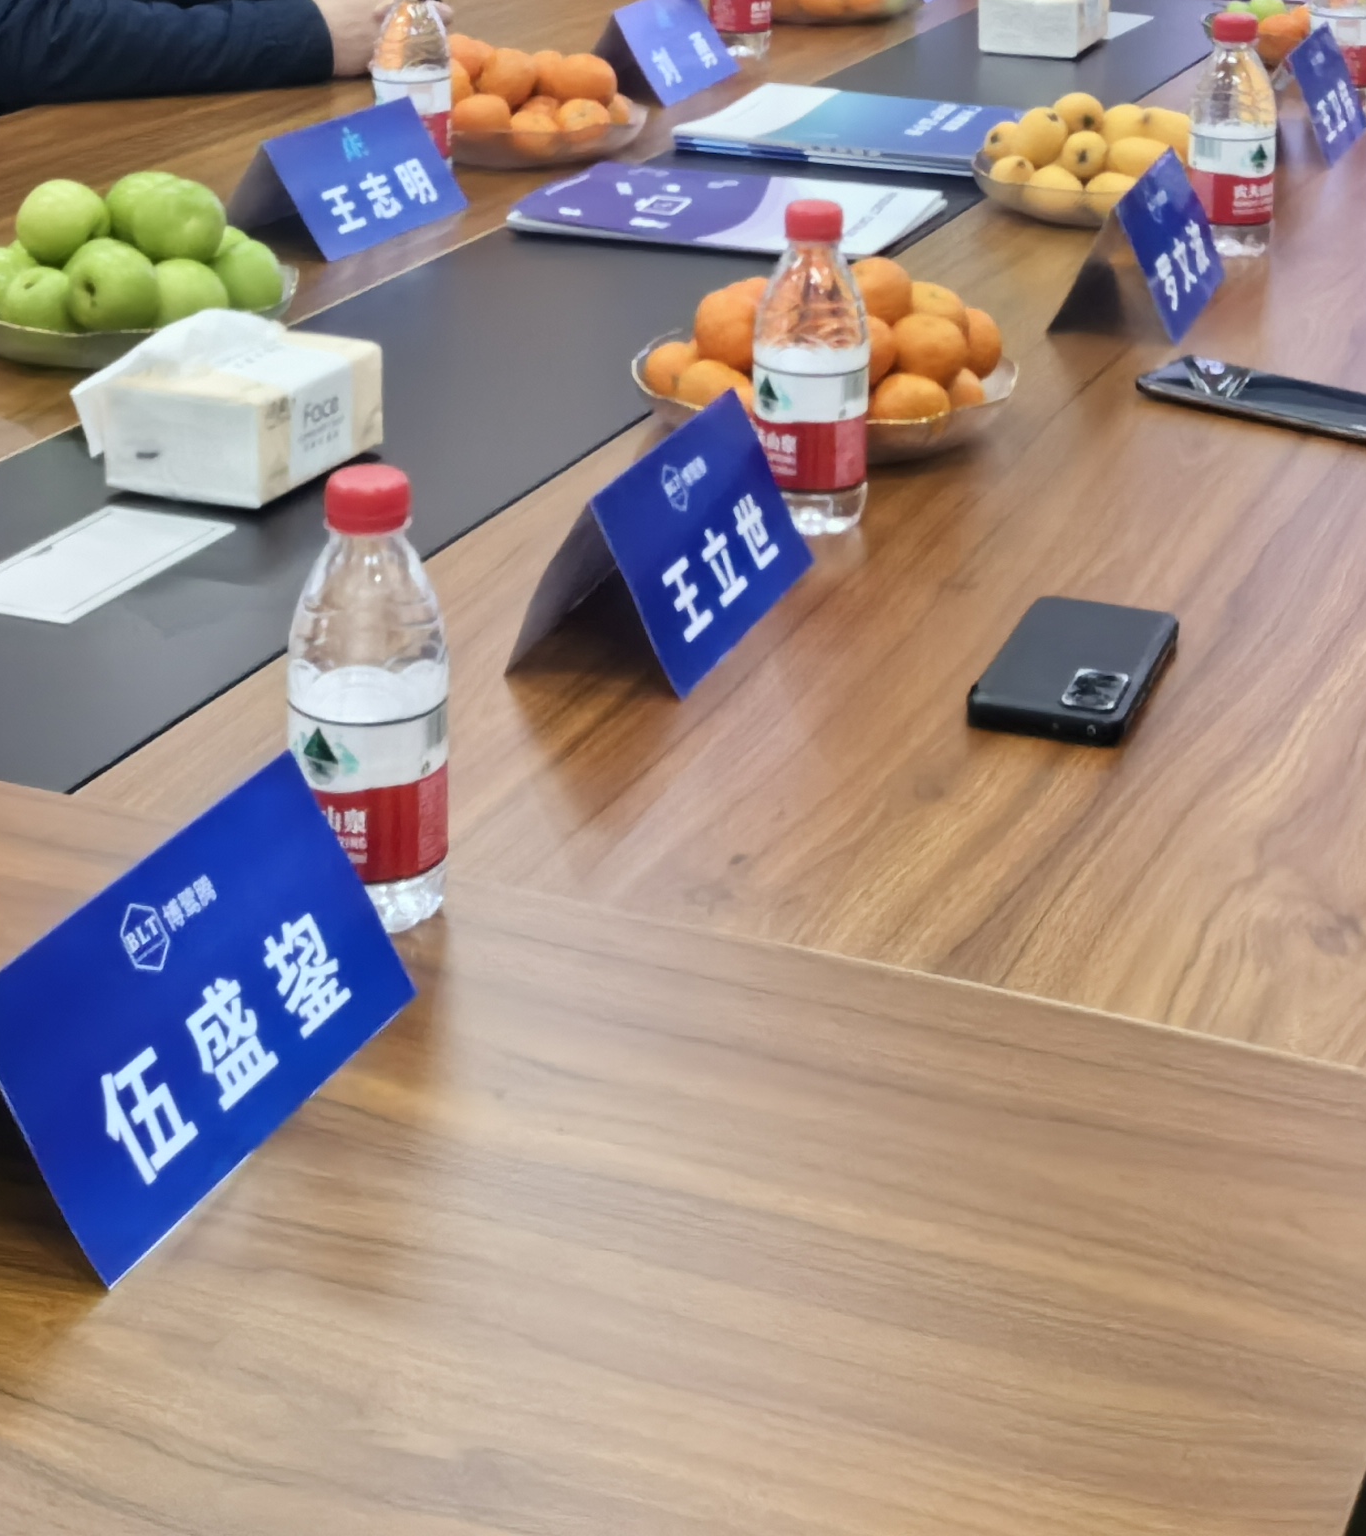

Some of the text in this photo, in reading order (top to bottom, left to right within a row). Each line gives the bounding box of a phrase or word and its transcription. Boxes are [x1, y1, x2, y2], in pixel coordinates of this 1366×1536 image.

[321, 157, 439, 235] 王志明
[661, 493, 780, 644] 王立世
[123, 910, 161, 954] BLT
[101, 911, 352, 1186] 伍盛鋆
